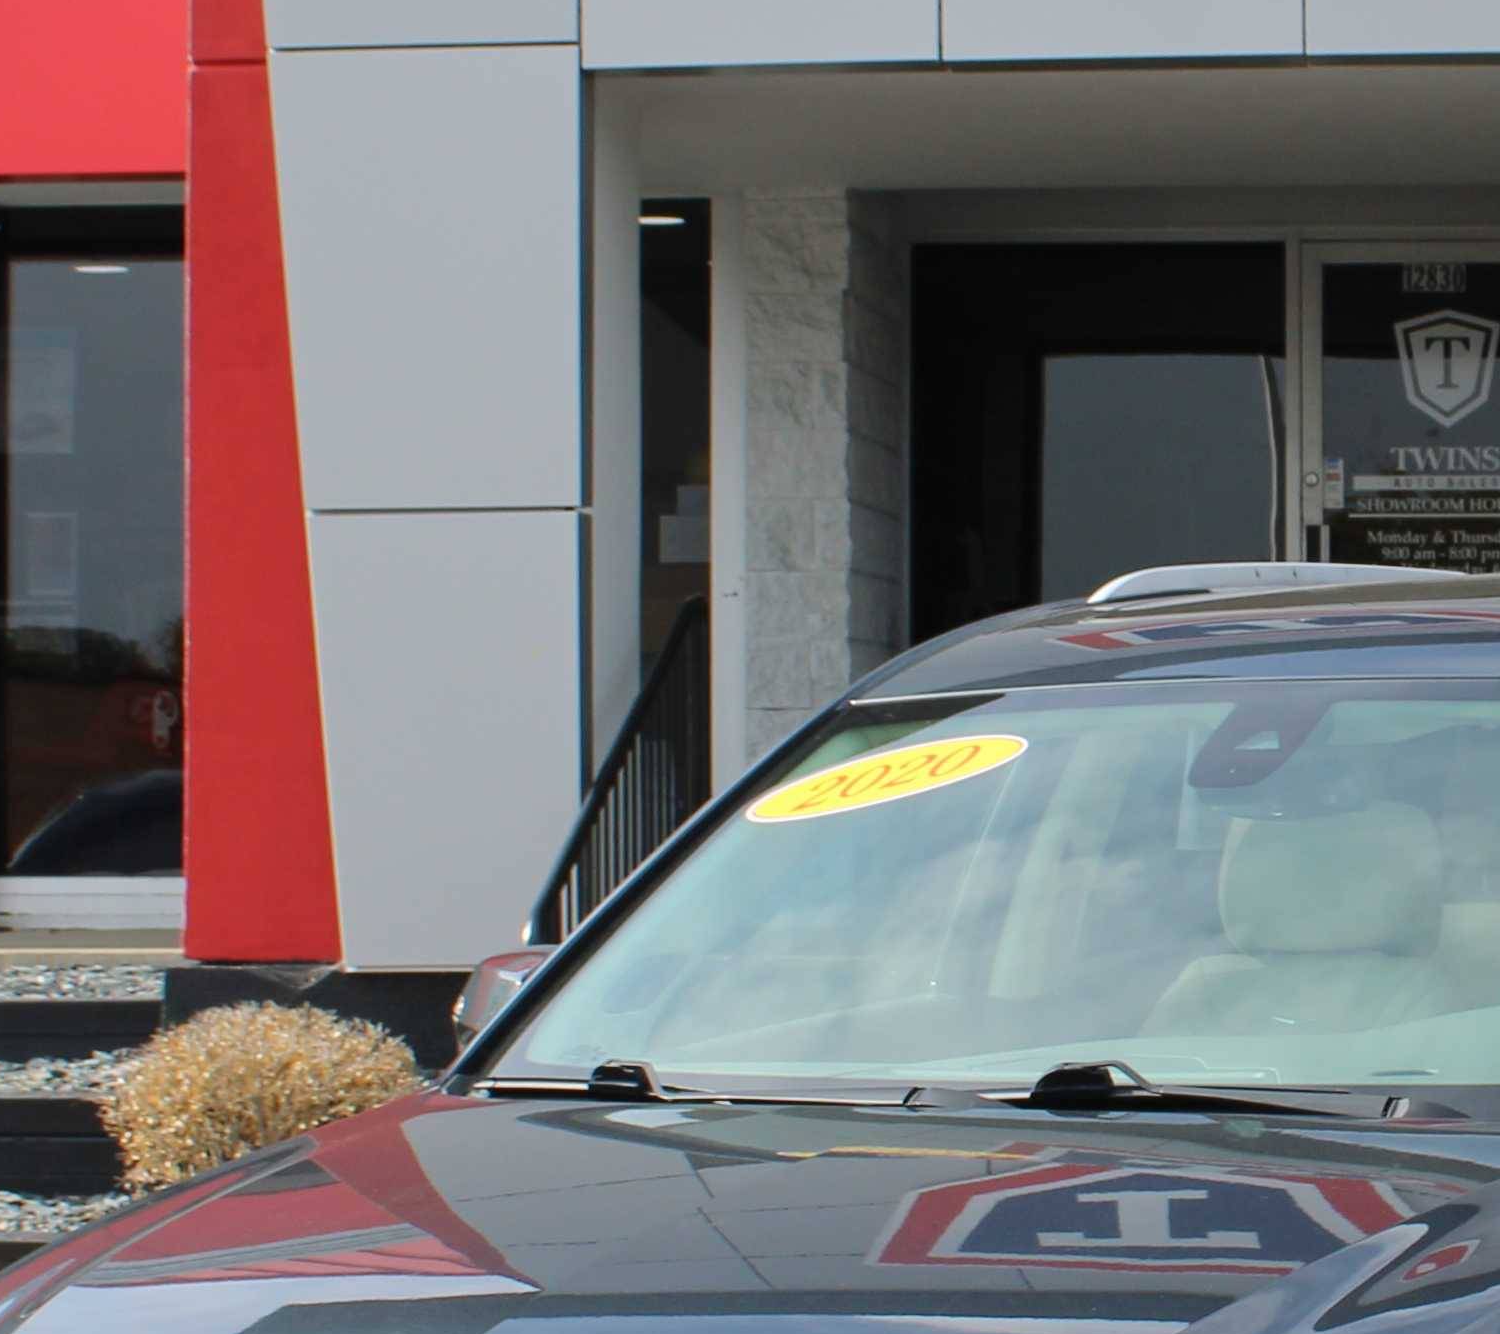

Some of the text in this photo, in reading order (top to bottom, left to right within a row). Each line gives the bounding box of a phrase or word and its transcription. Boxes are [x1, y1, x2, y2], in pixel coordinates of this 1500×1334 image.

[1424, 336, 1470, 389] T
[1393, 477, 1436, 488] AUTO
[1356, 497, 1465, 513] SHOWROOM
[1366, 529, 1429, 547] Monday
[1413, 549, 1436, 560] am
[789, 744, 981, 812] 2020
